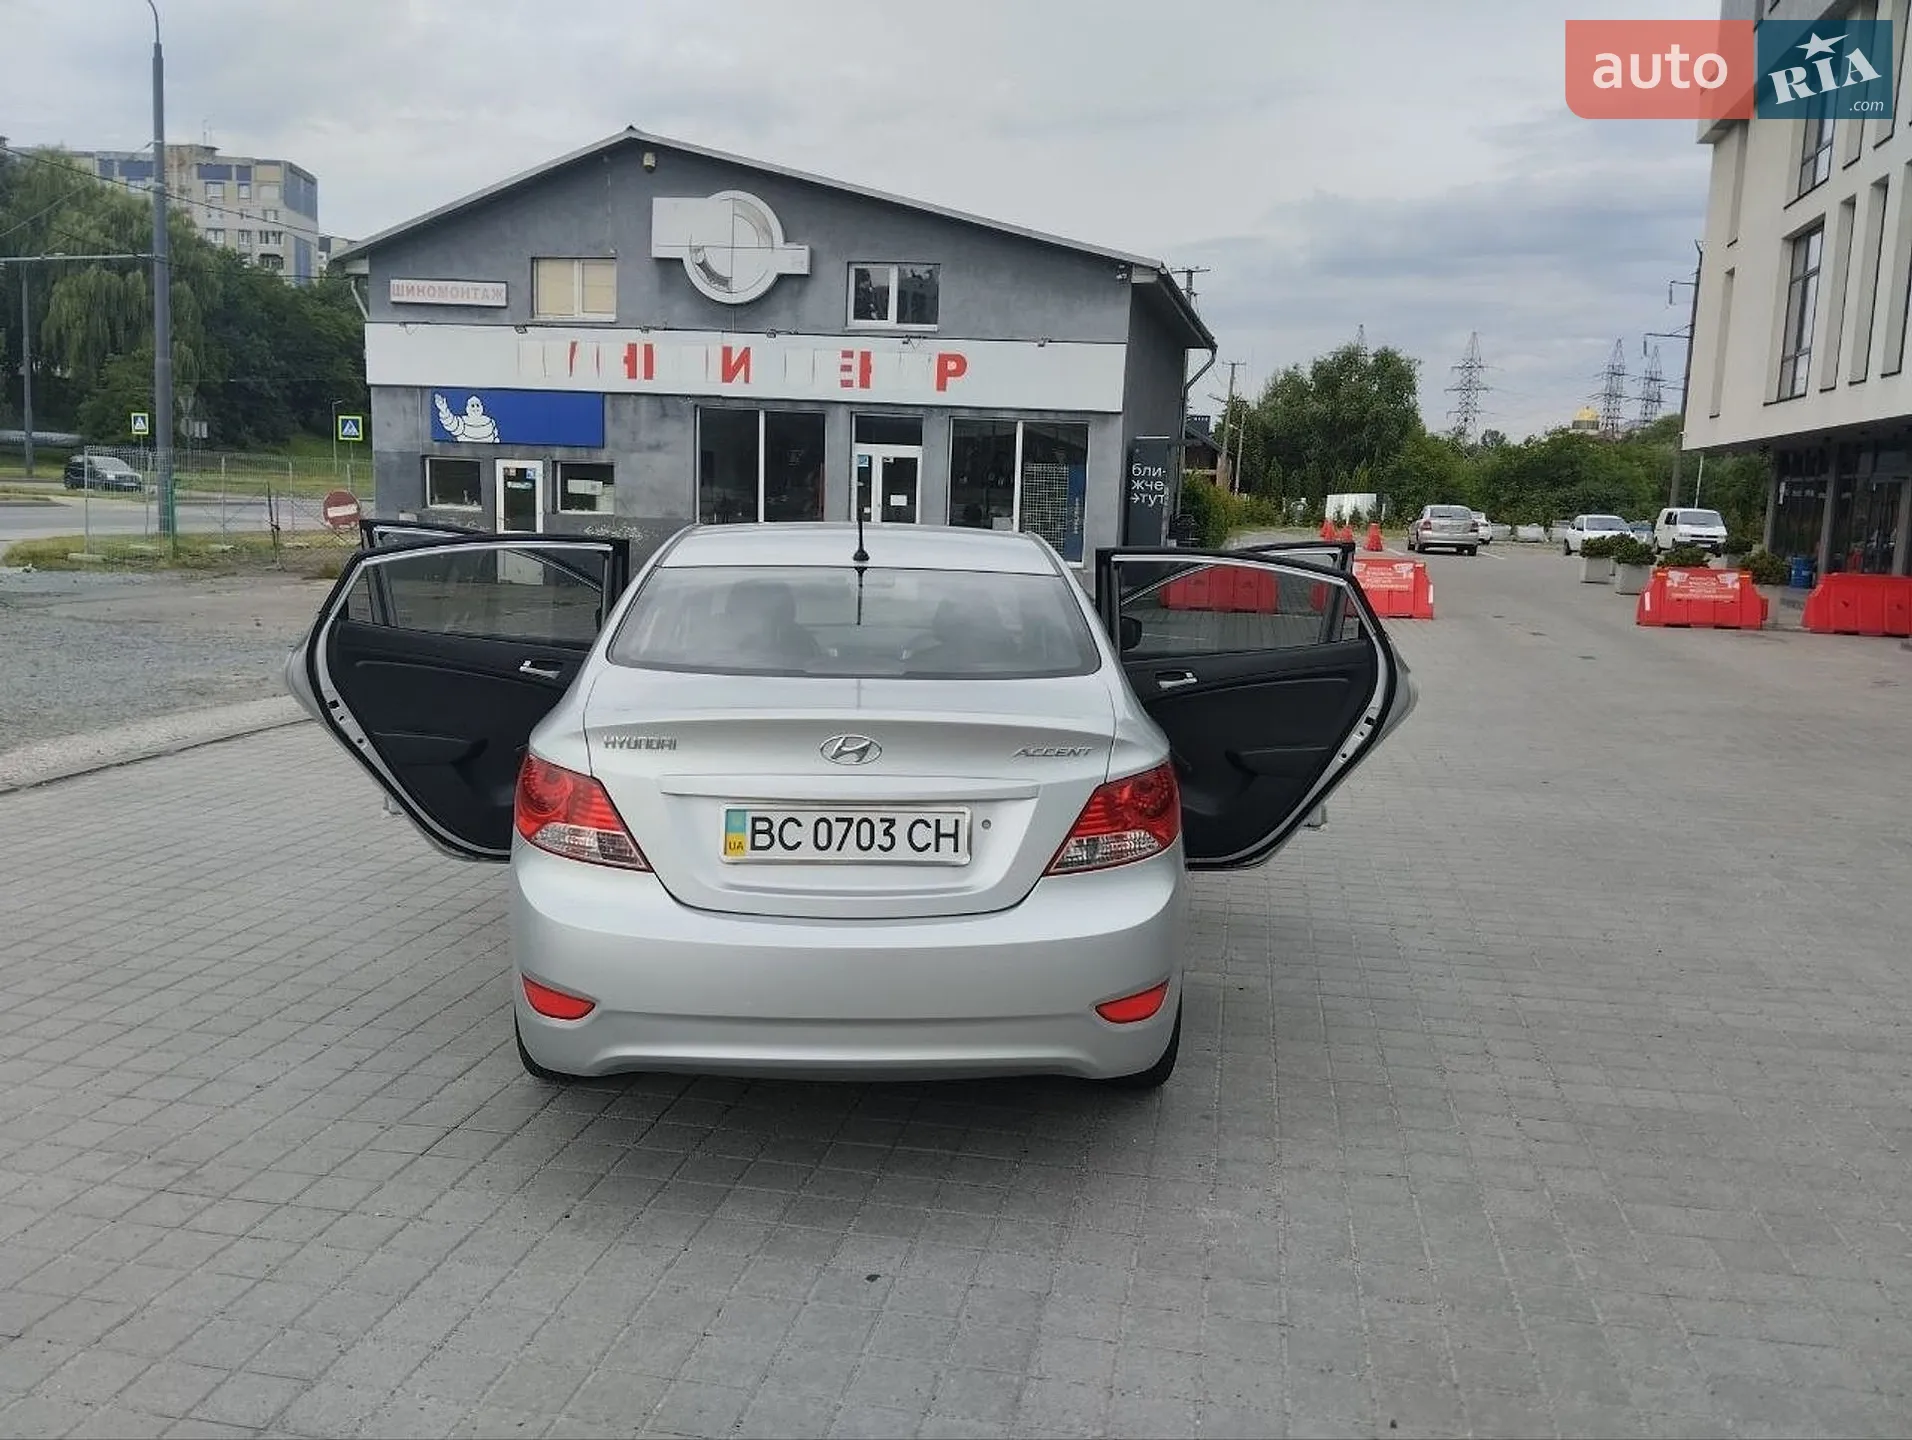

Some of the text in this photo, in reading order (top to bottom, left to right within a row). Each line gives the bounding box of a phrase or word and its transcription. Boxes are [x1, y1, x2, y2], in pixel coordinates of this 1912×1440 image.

[603, 735, 677, 750] HYUNDAI
[1011, 747, 1094, 758] ACCENT
[750, 816, 959, 853] BC 0703 CH
[728, 841, 744, 851] UA
